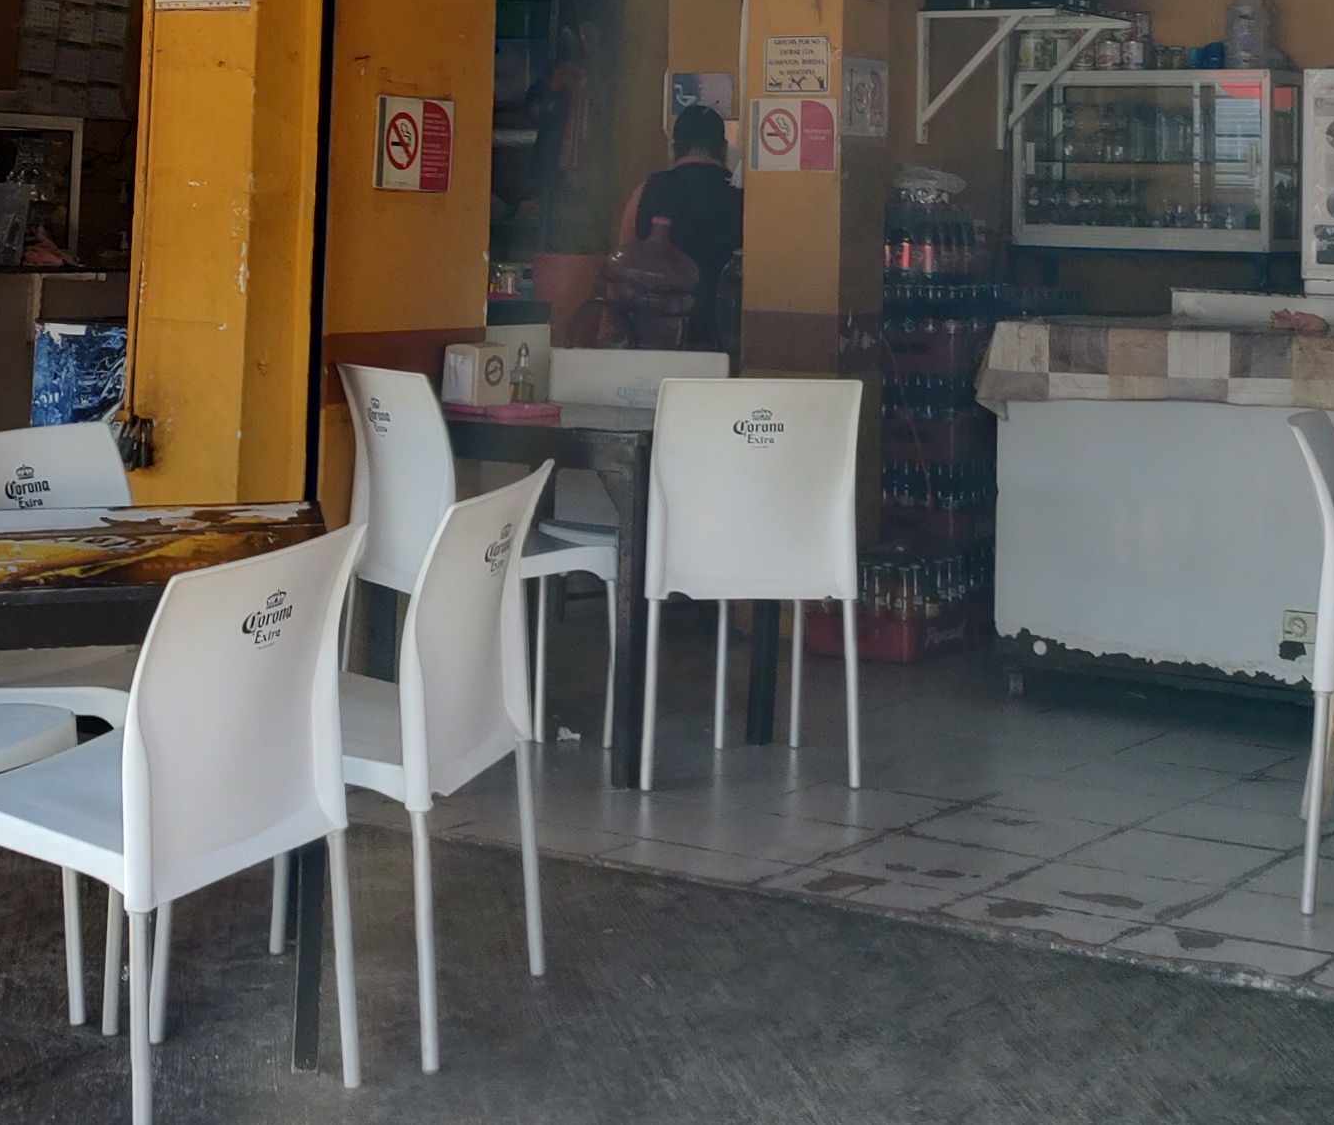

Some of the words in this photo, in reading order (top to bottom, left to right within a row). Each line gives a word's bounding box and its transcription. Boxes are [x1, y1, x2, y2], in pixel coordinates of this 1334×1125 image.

[733, 419, 784, 436] Corona
[747, 433, 775, 444] Extra
[5, 480, 50, 500] Corona
[242, 605, 293, 635] Corona
